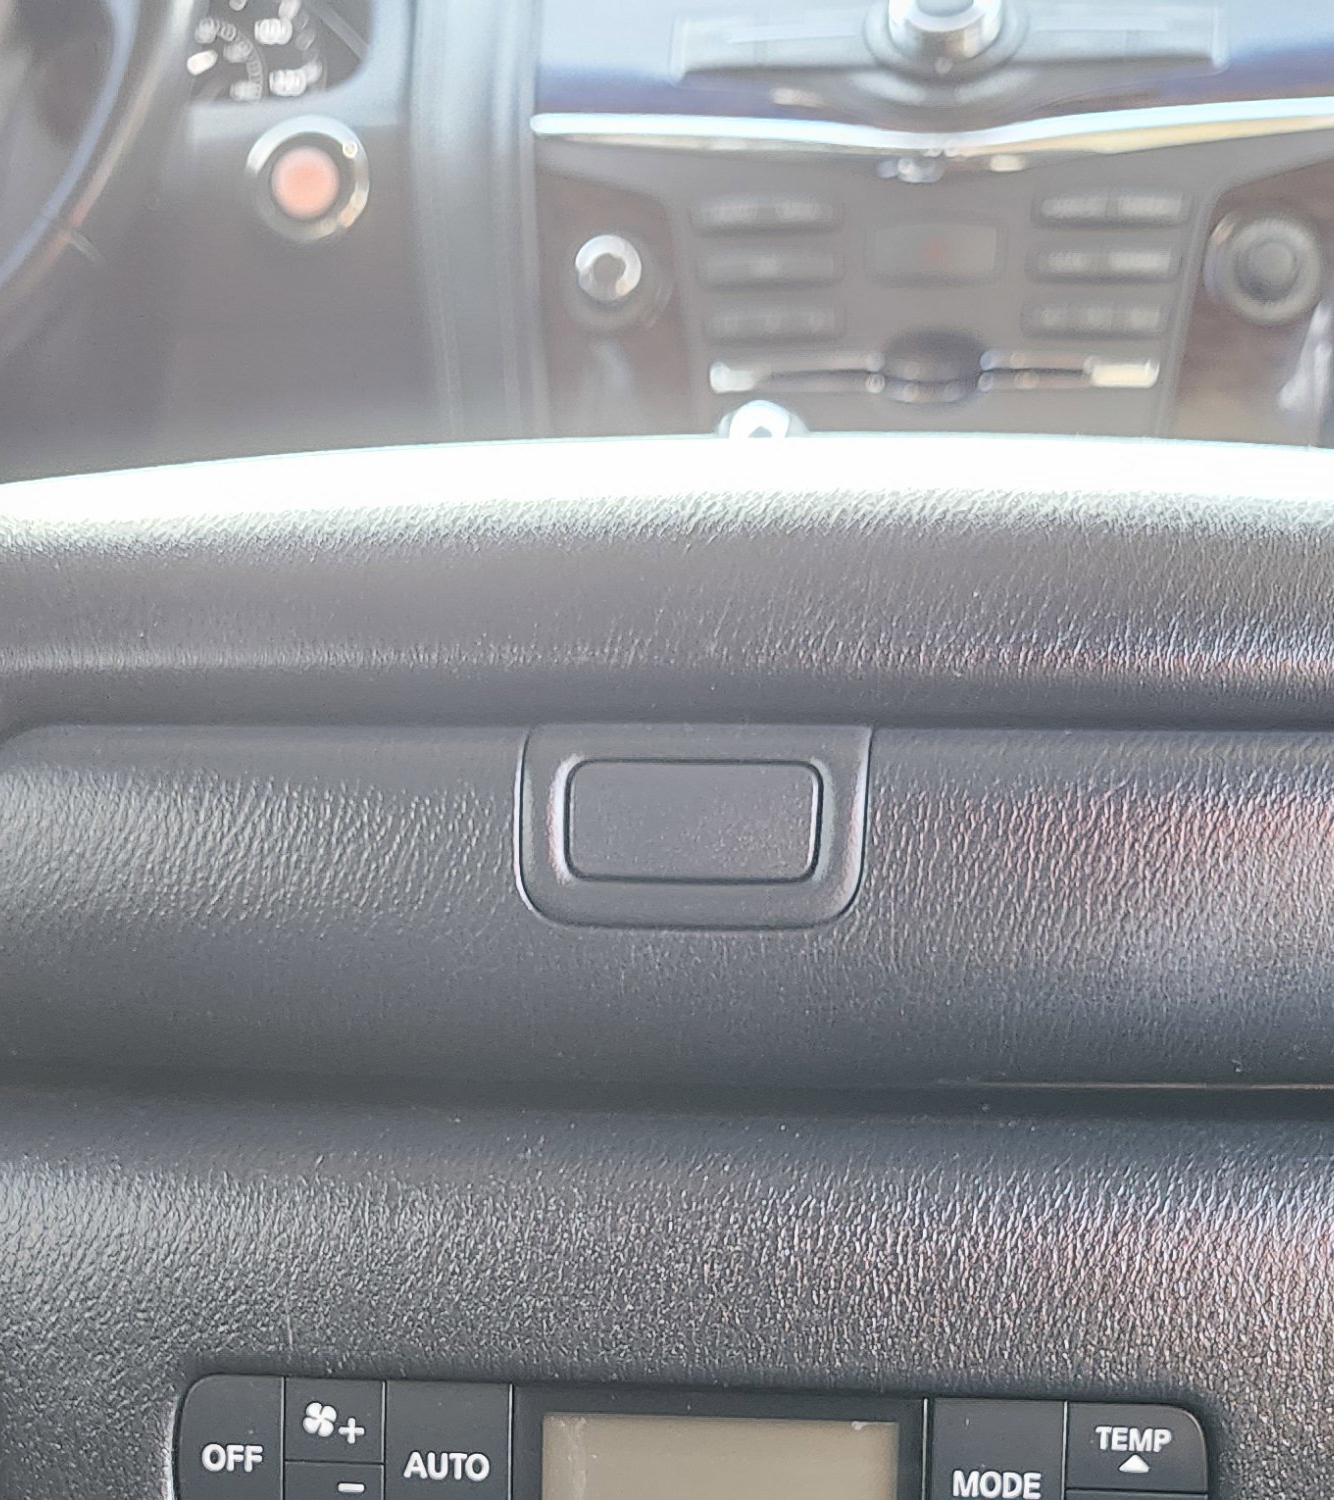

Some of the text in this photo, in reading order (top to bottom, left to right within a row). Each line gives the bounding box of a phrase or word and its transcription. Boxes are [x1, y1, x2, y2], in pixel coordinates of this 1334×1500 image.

[1095, 1426, 1172, 1451] TEMP
[201, 1443, 263, 1473] OFF
[403, 1451, 490, 1482] AUTO
[952, 1468, 1042, 1500] MODE
